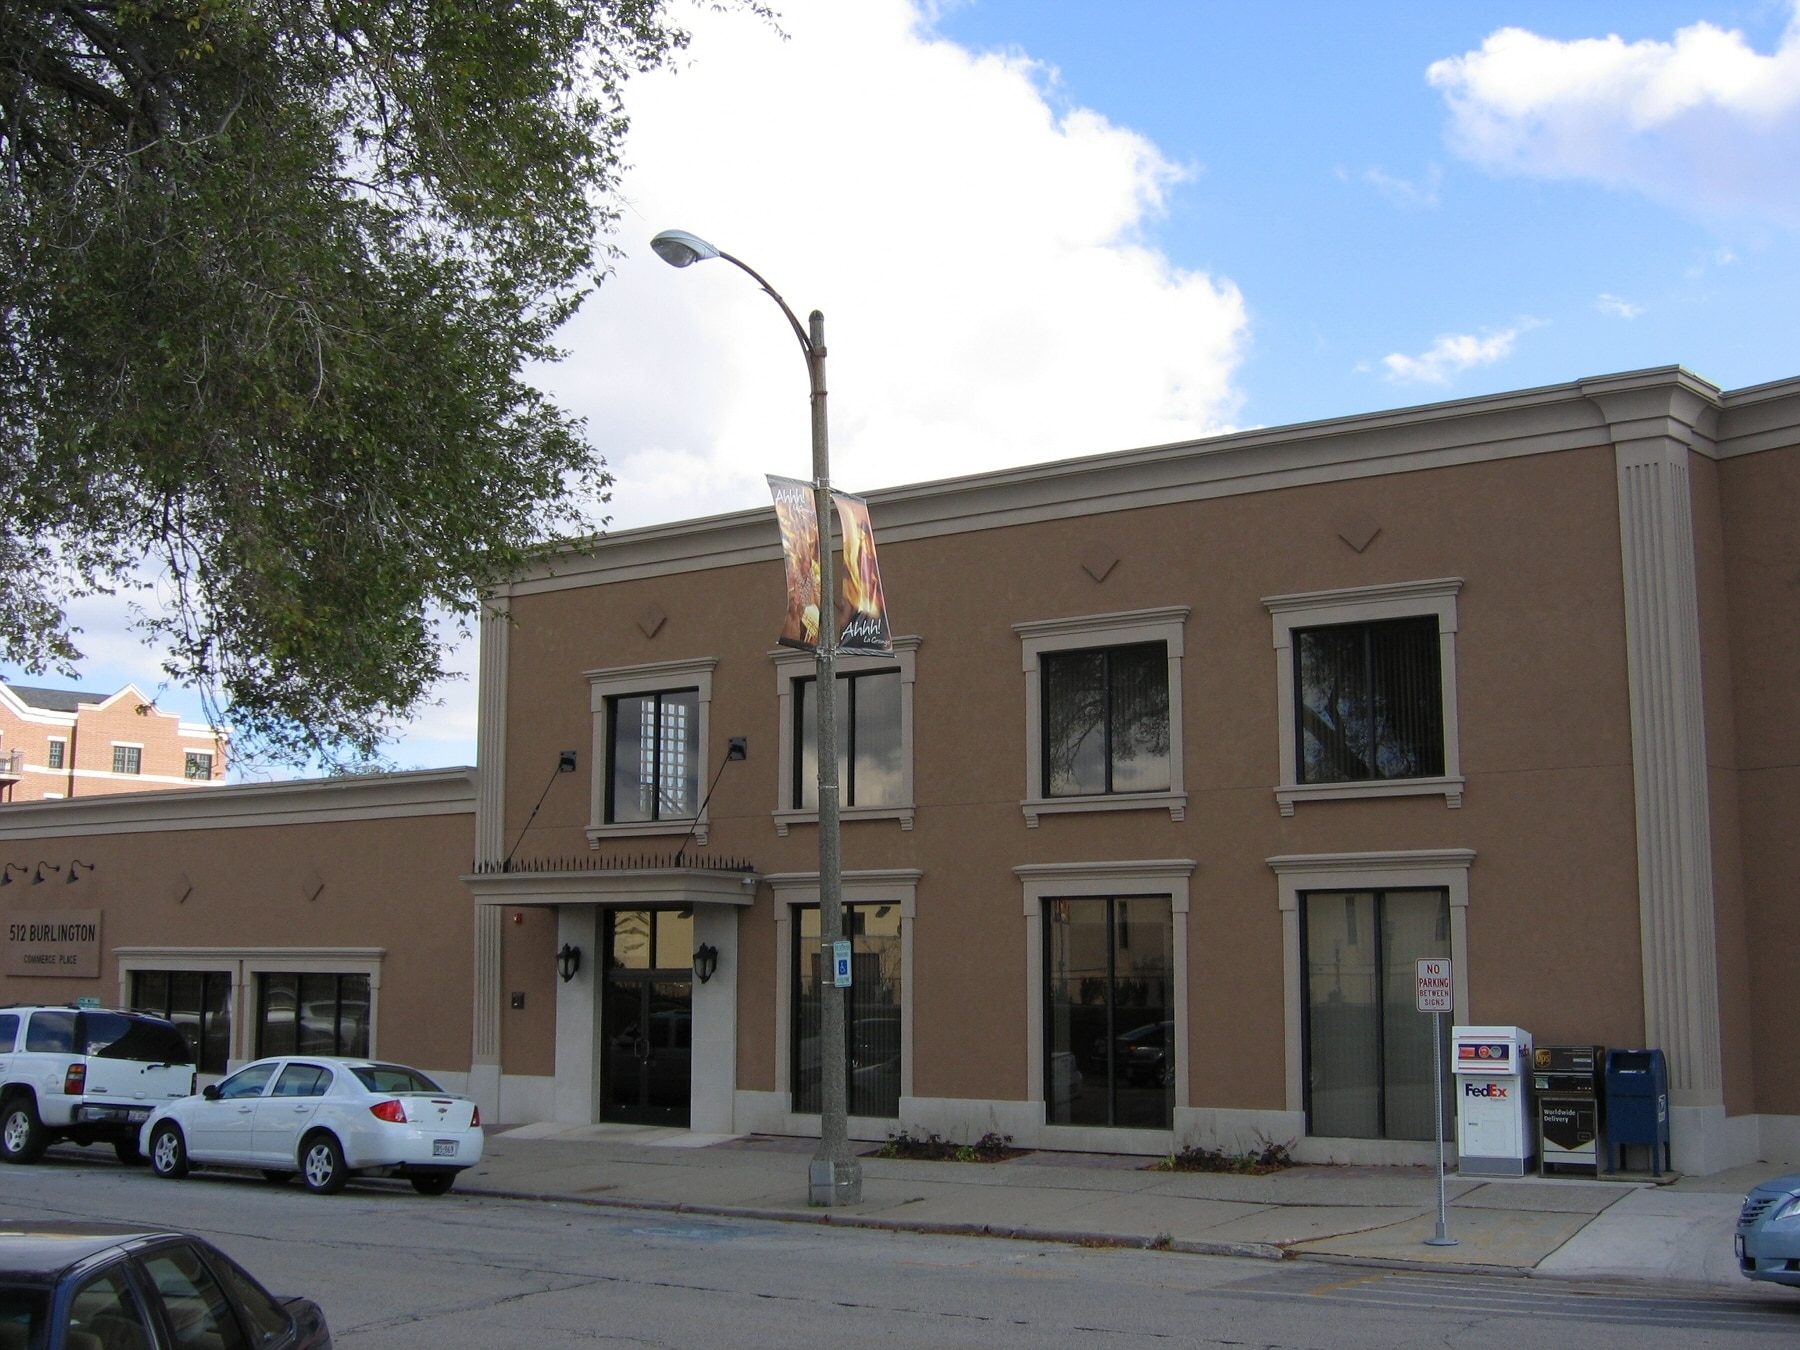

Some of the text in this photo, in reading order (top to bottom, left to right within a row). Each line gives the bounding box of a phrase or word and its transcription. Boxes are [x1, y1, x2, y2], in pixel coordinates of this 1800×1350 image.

[775, 488, 805, 504] Ahhh!
[840, 618, 881, 640] Ahhh!
[9, 924, 96, 942] 512 BURLINGTON
[1426, 964, 1440, 974] NO
[1419, 977, 1449, 988] PARKING
[1419, 989, 1449, 997] BETWEEN
[1424, 998, 1445, 1006] SIGNS
[1464, 1083, 1508, 1098] FedEx
[1543, 1108, 1576, 1116] Worldwide
[1543, 1115, 1569, 1124] Delivery
